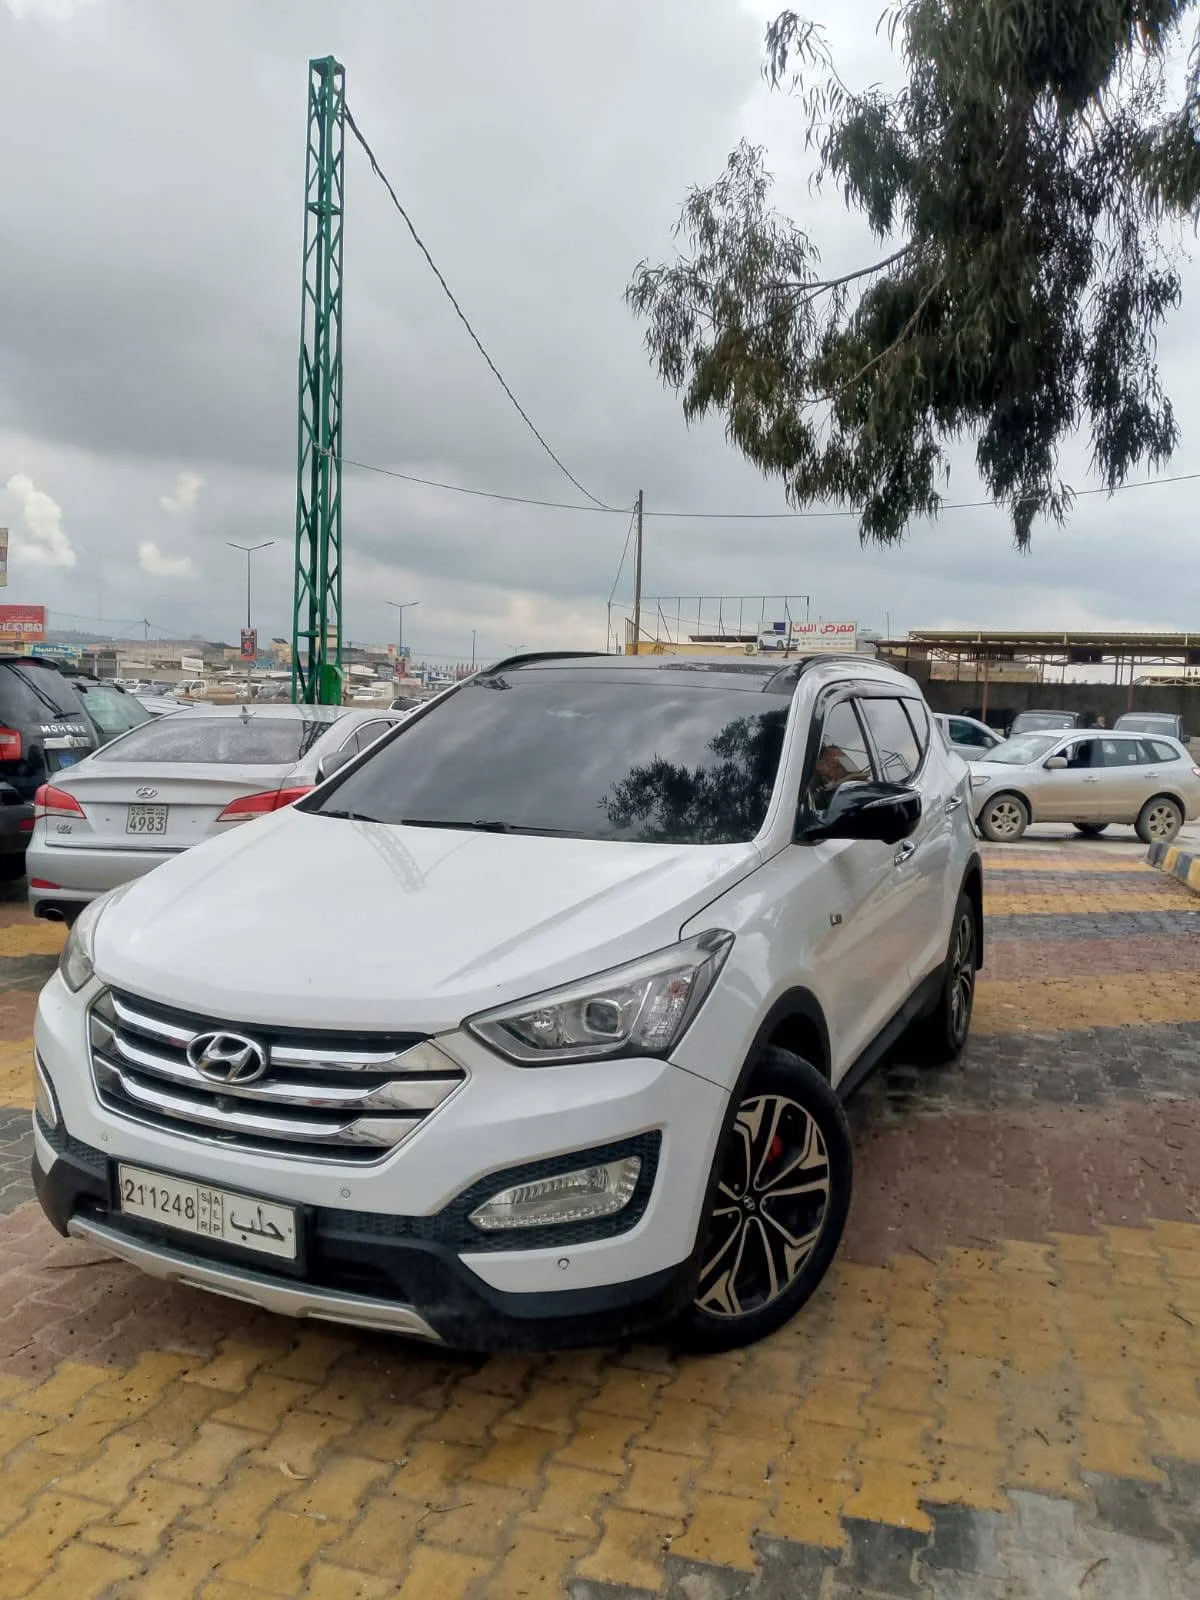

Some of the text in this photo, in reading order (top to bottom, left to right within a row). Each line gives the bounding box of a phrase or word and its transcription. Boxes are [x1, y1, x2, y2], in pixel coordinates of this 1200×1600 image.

[820, 623, 854, 634] معرض
[129, 816, 165, 831] 4983
[124, 1178, 195, 1219] 211248
[230, 1206, 285, 1242] حلب
